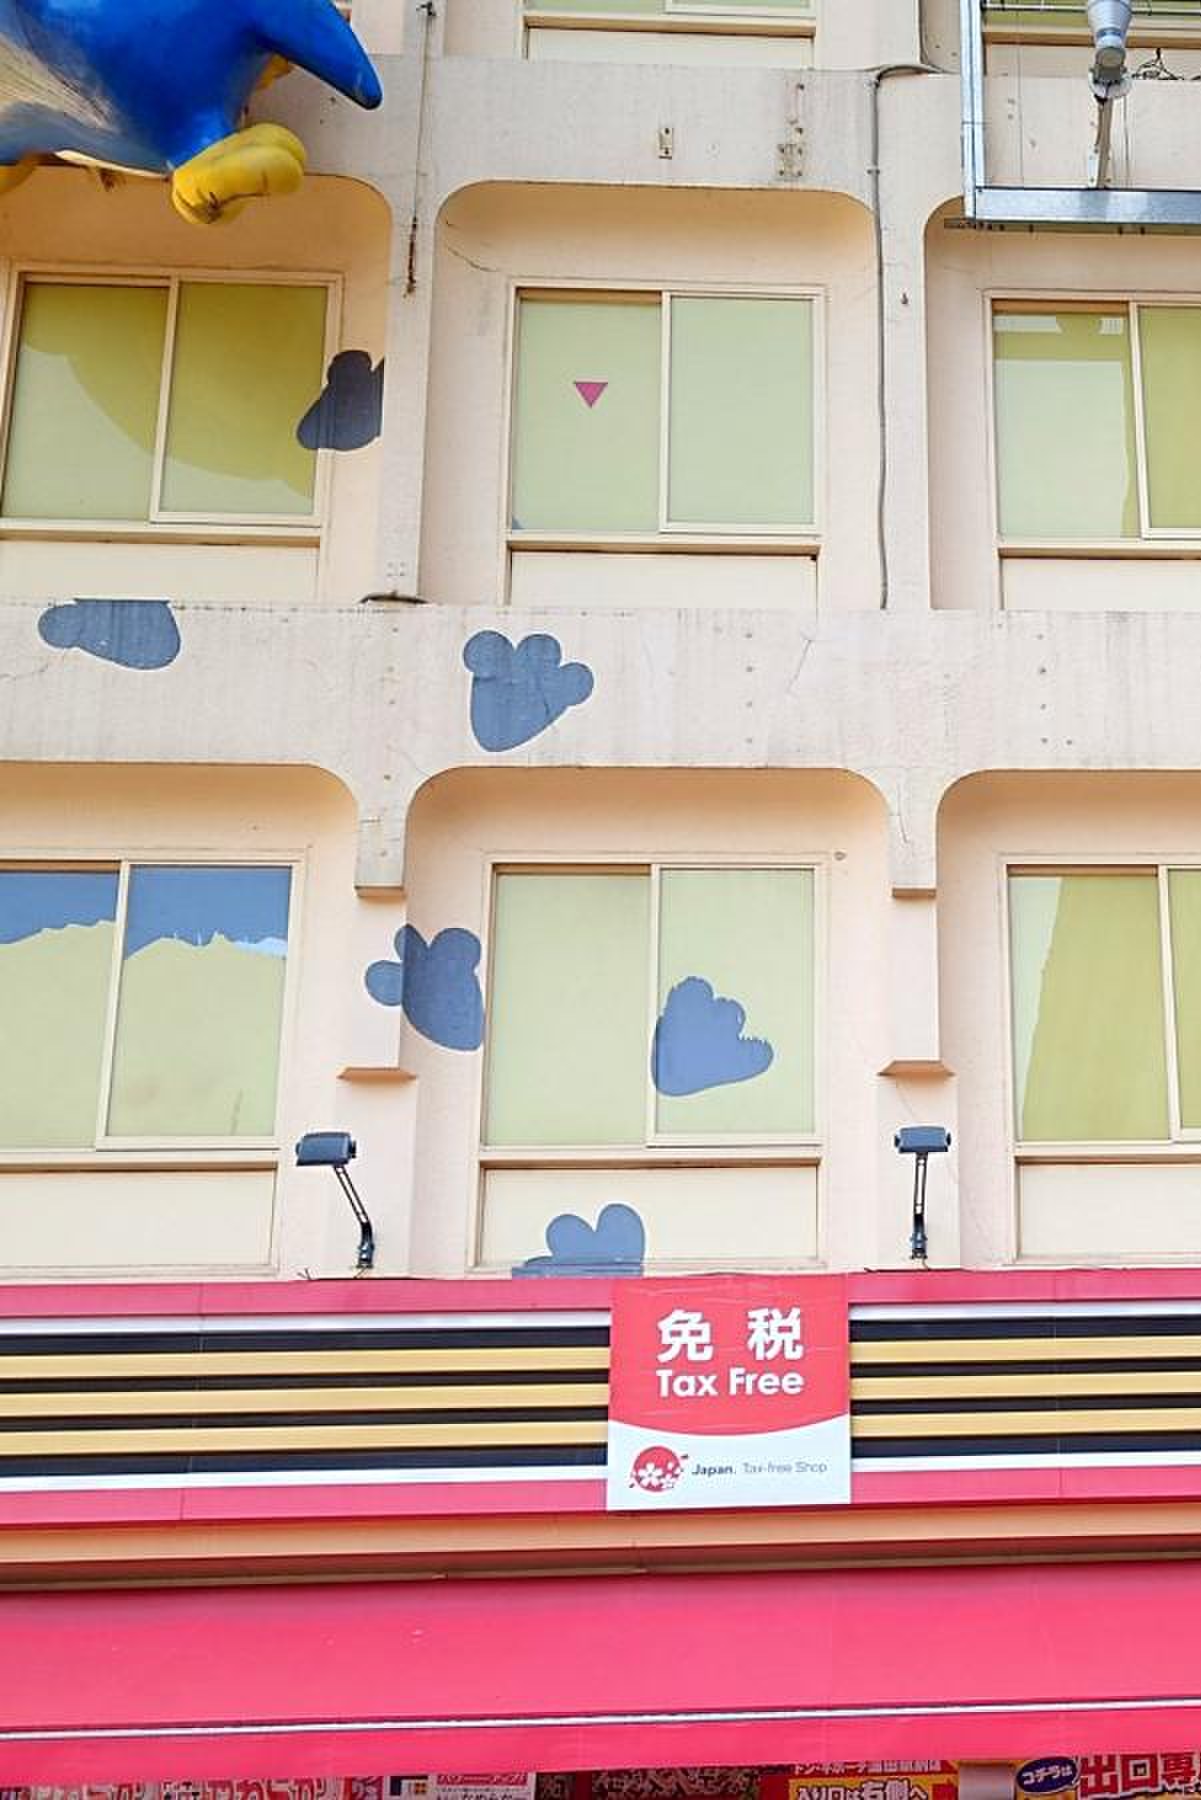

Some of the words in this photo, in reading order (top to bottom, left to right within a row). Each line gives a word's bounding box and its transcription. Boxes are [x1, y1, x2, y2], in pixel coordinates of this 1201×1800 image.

[656, 1368, 718, 1398] Tax
[729, 1366, 804, 1396] Free
[691, 1463, 736, 1477] Japan.
[795, 1460, 827, 1474] Shop
